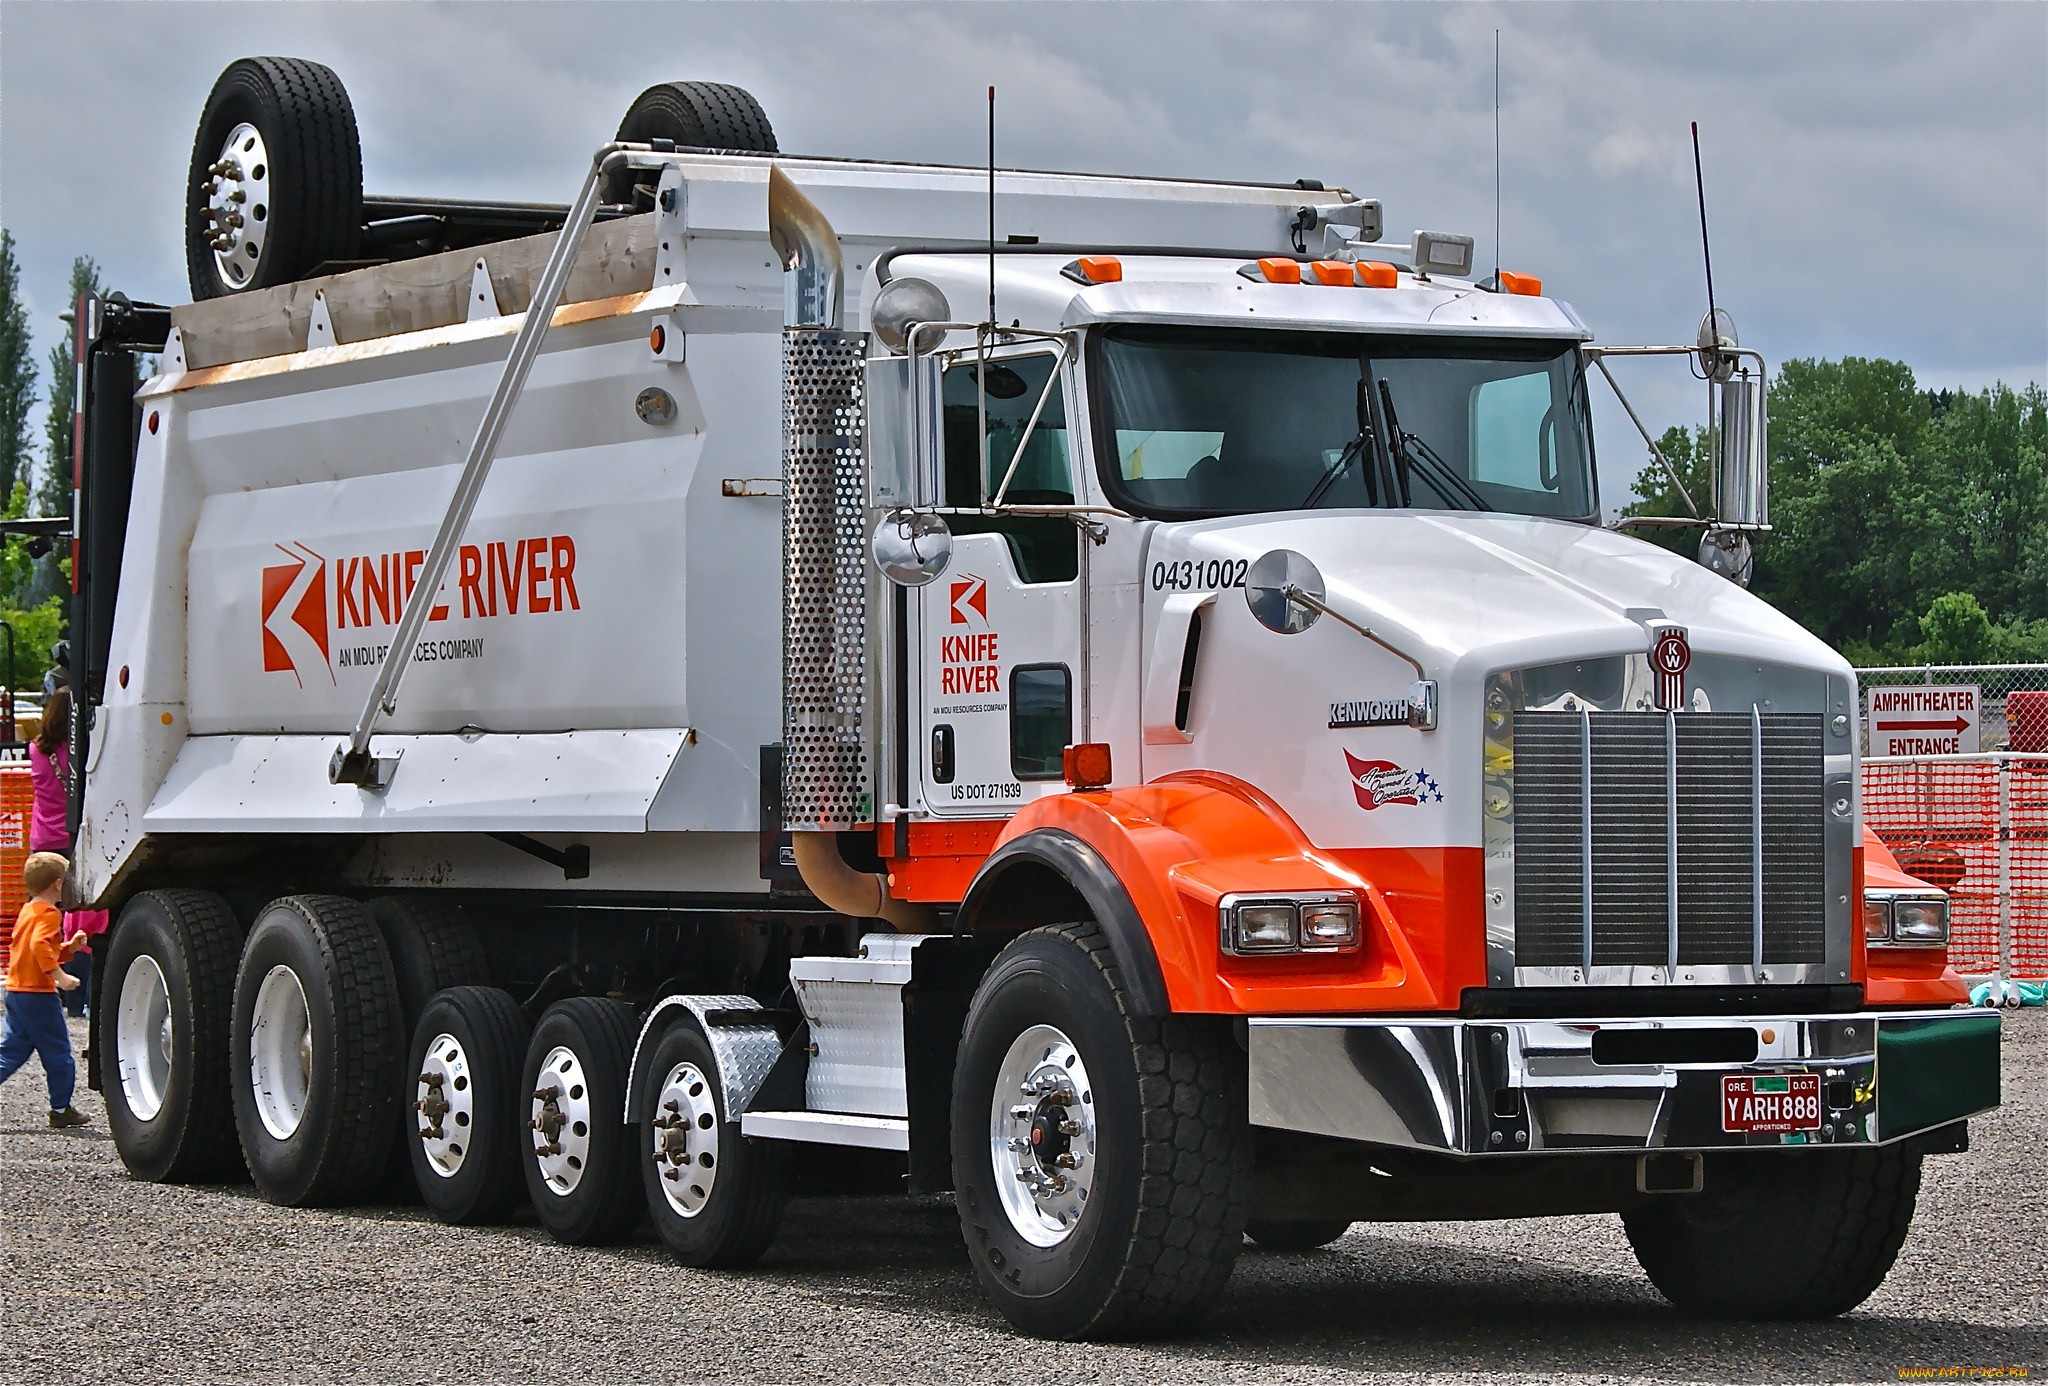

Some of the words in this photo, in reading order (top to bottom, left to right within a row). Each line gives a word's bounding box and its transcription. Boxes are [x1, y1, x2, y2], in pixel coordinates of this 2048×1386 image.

[459, 535, 581, 619] RIVER
[1152, 559, 1249, 591] 0431002
[339, 648, 352, 667] AN
[354, 646, 375, 666] MDU
[378, 641, 437, 664] RECES
[440, 638, 483, 660] COMPANY
[941, 633, 999, 663] KNIFE
[942, 665, 1000, 695] RIVER
[953, 704, 983, 713] RESOURCES
[983, 703, 1008, 712] COMPANY
[1873, 692, 1974, 712] AMPHITHEATER
[1329, 700, 1409, 723] KENWORTH
[1889, 738, 1960, 755] ENTRANCE
[1361, 768, 1408, 783] American
[1371, 776, 1405, 791] Owned
[951, 784, 964, 799] US
[966, 784, 986, 799] DOT
[988, 782, 1022, 798] 271939
[1374, 786, 1419, 803] Operated
[1728, 1082, 1749, 1092] ORE.
[1793, 1080, 1816, 1090] D.O.T.
[1752, 1123, 1791, 1131] APPORTIONED
